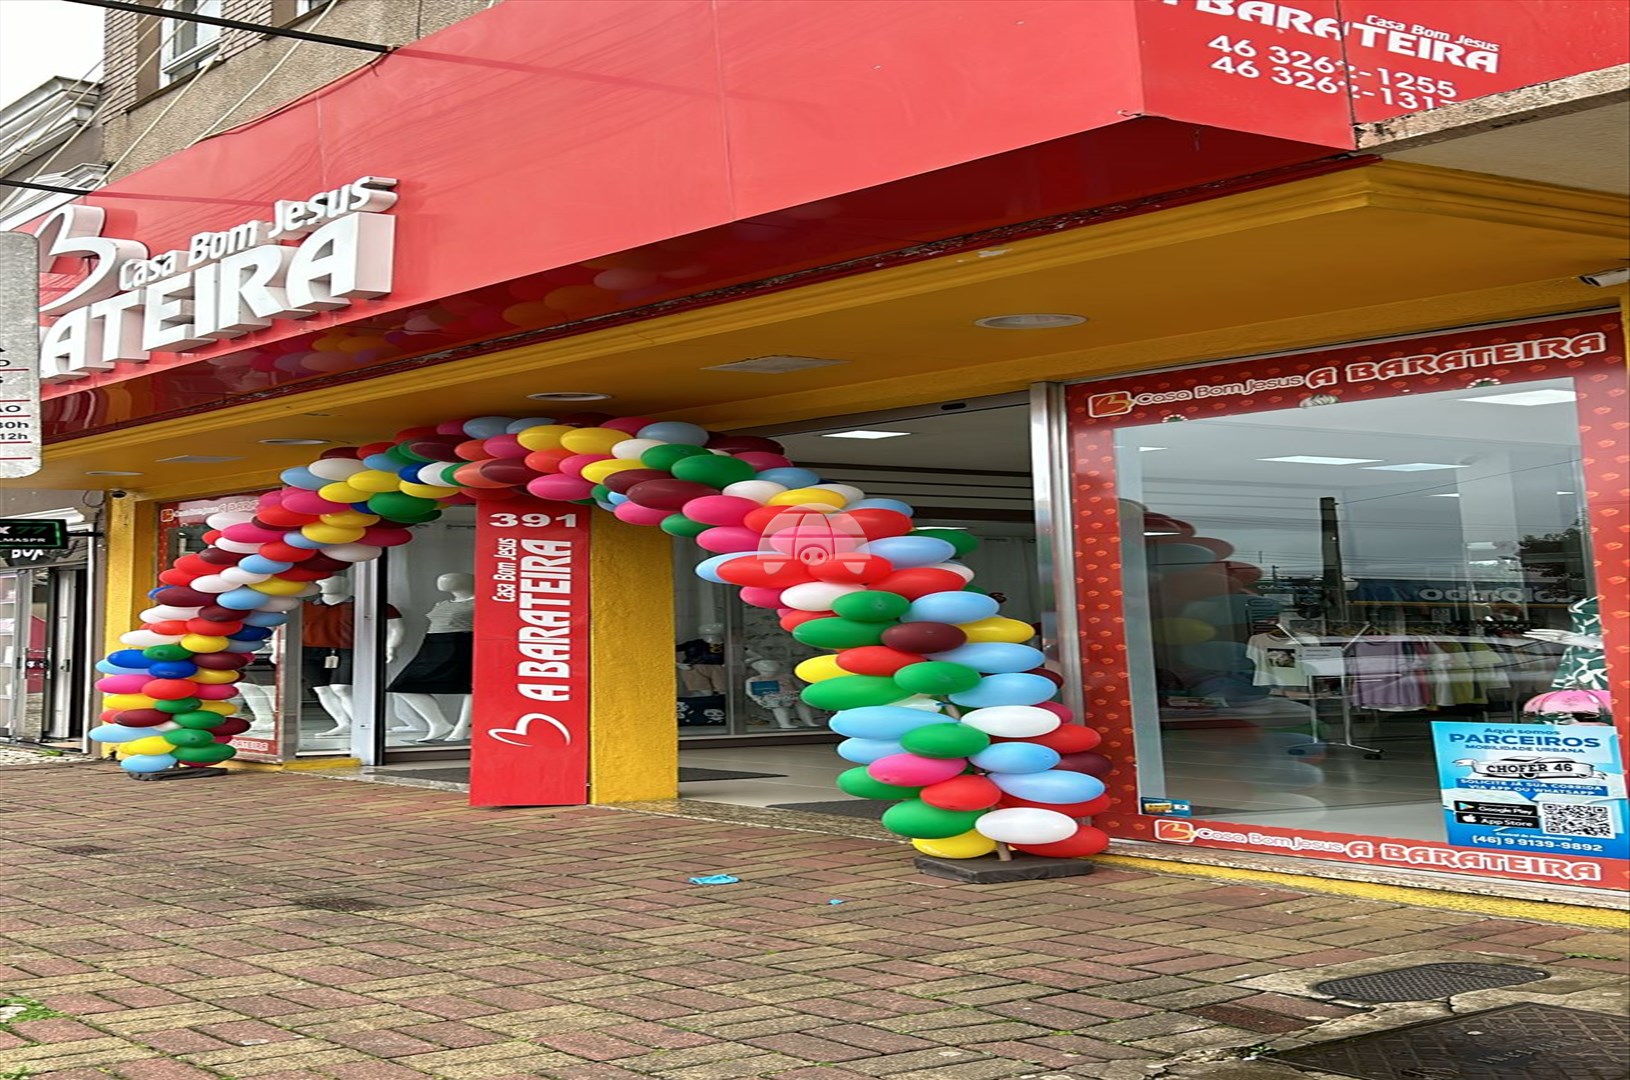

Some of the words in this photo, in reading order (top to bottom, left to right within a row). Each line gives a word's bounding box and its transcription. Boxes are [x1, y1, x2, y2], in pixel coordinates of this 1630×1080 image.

[1366, 15, 1406, 31] Casa
[1411, 24, 1450, 41] Bom
[1456, 35, 1500, 52] Jesus
[1208, 35, 1257, 57] 46
[1211, 56, 1260, 78] 46
[119, 250, 177, 291] Casa
[188, 221, 258, 265] Bom
[267, 177, 398, 238] Jesus
[40, 213, 395, 382] ATEIRA
[1135, 389, 1193, 406] Casa
[1194, 382, 1243, 399] Bom
[1242, 375, 1305, 395] Jesus
[1305, 366, 1338, 389] A
[1346, 332, 1606, 382] BARATEIRA
[489, 512, 577, 528] 391
[493, 538, 518, 560] Jesus
[492, 562, 517, 581] Bom
[491, 583, 516, 602] Casa
[517, 539, 572, 679] BARATEIRA
[517, 683, 571, 701] A
[1484, 727, 1515, 735] Aqui
[1449, 733, 1601, 748] PARCEIROS
[1464, 744, 1533, 752] MOBILIDADE
[1486, 764, 1548, 774] CHOFER
[1554, 763, 1573, 772] 46
[1460, 778, 1508, 786] SOLICITE
[1550, 783, 1603, 791] CORRIDA
[1534, 787, 1596, 796] WHATSAPP
[1478, 805, 1512, 814] Google
[1513, 808, 1534, 816] Play
[1480, 818, 1504, 826] App
[1505, 819, 1534, 827] Store
[1472, 835, 1502, 845] (46)
[1504, 837, 1515, 845] 9
[1518, 838, 1603, 852] 9139-9892
[1197, 827, 1248, 844] Casa
[1248, 832, 1291, 848] Bom
[1291, 836, 1345, 853] Jesus
[1345, 841, 1374, 858] A
[1380, 843, 1602, 881] BARATEIRA
